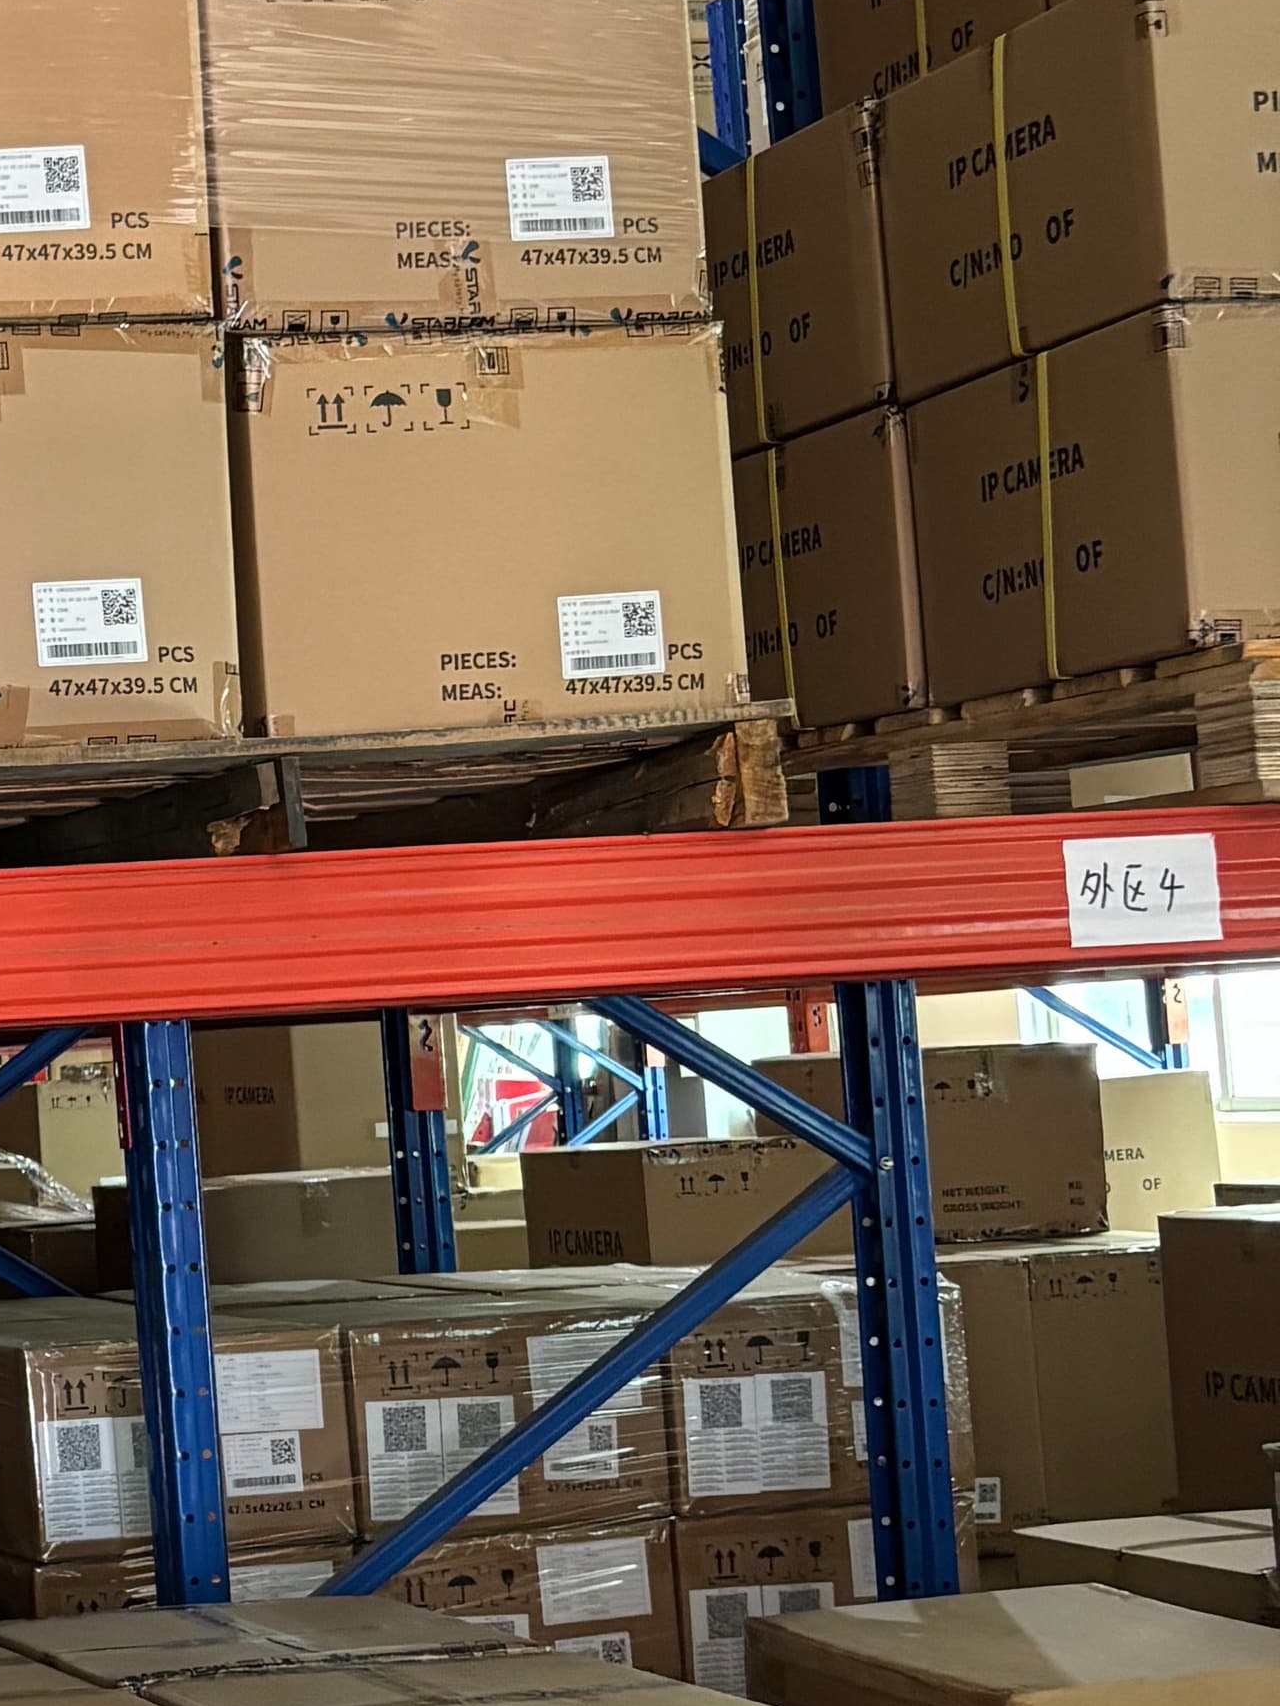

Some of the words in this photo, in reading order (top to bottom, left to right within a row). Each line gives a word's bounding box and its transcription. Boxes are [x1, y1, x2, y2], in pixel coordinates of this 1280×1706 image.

[951, 21, 974, 53] OF
[949, 156, 968, 189] IP
[111, 212, 149, 229] PCS
[395, 220, 470, 239] PIECES:
[623, 217, 659, 234] PCS
[1046, 209, 1075, 245] OF
[1, 244, 116, 261] 47x47x39.5
[122, 243, 152, 260] CM
[521, 248, 628, 266] 47x47x39.5
[634, 247, 662, 264] CM
[713, 257, 730, 289] IP
[789, 313, 811, 343] OF
[981, 472, 999, 502] IP
[1003, 444, 1084, 494] CAMERA
[741, 543, 758, 570] IP
[1076, 541, 1103, 572] OF
[815, 610, 839, 639] OF
[158, 646, 194, 663] PCS
[440, 651, 516, 671] PIECES:
[668, 643, 703, 660] PCS
[49, 677, 163, 696] 47x47x39.5
[170, 676, 198, 693] CM
[442, 683, 502, 701] MEAS:
[566, 674, 672, 695] 47x47x39.5
[678, 673, 705, 691] CM
[1104, 1147, 1145, 1163] MERA
[1142, 1178, 1162, 1191] OF
[548, 1230, 564, 1255] IP
[566, 1229, 624, 1257] CAMERA
[1205, 1371, 1224, 1398] IP
[1231, 1375, 1280, 1405] CAM
